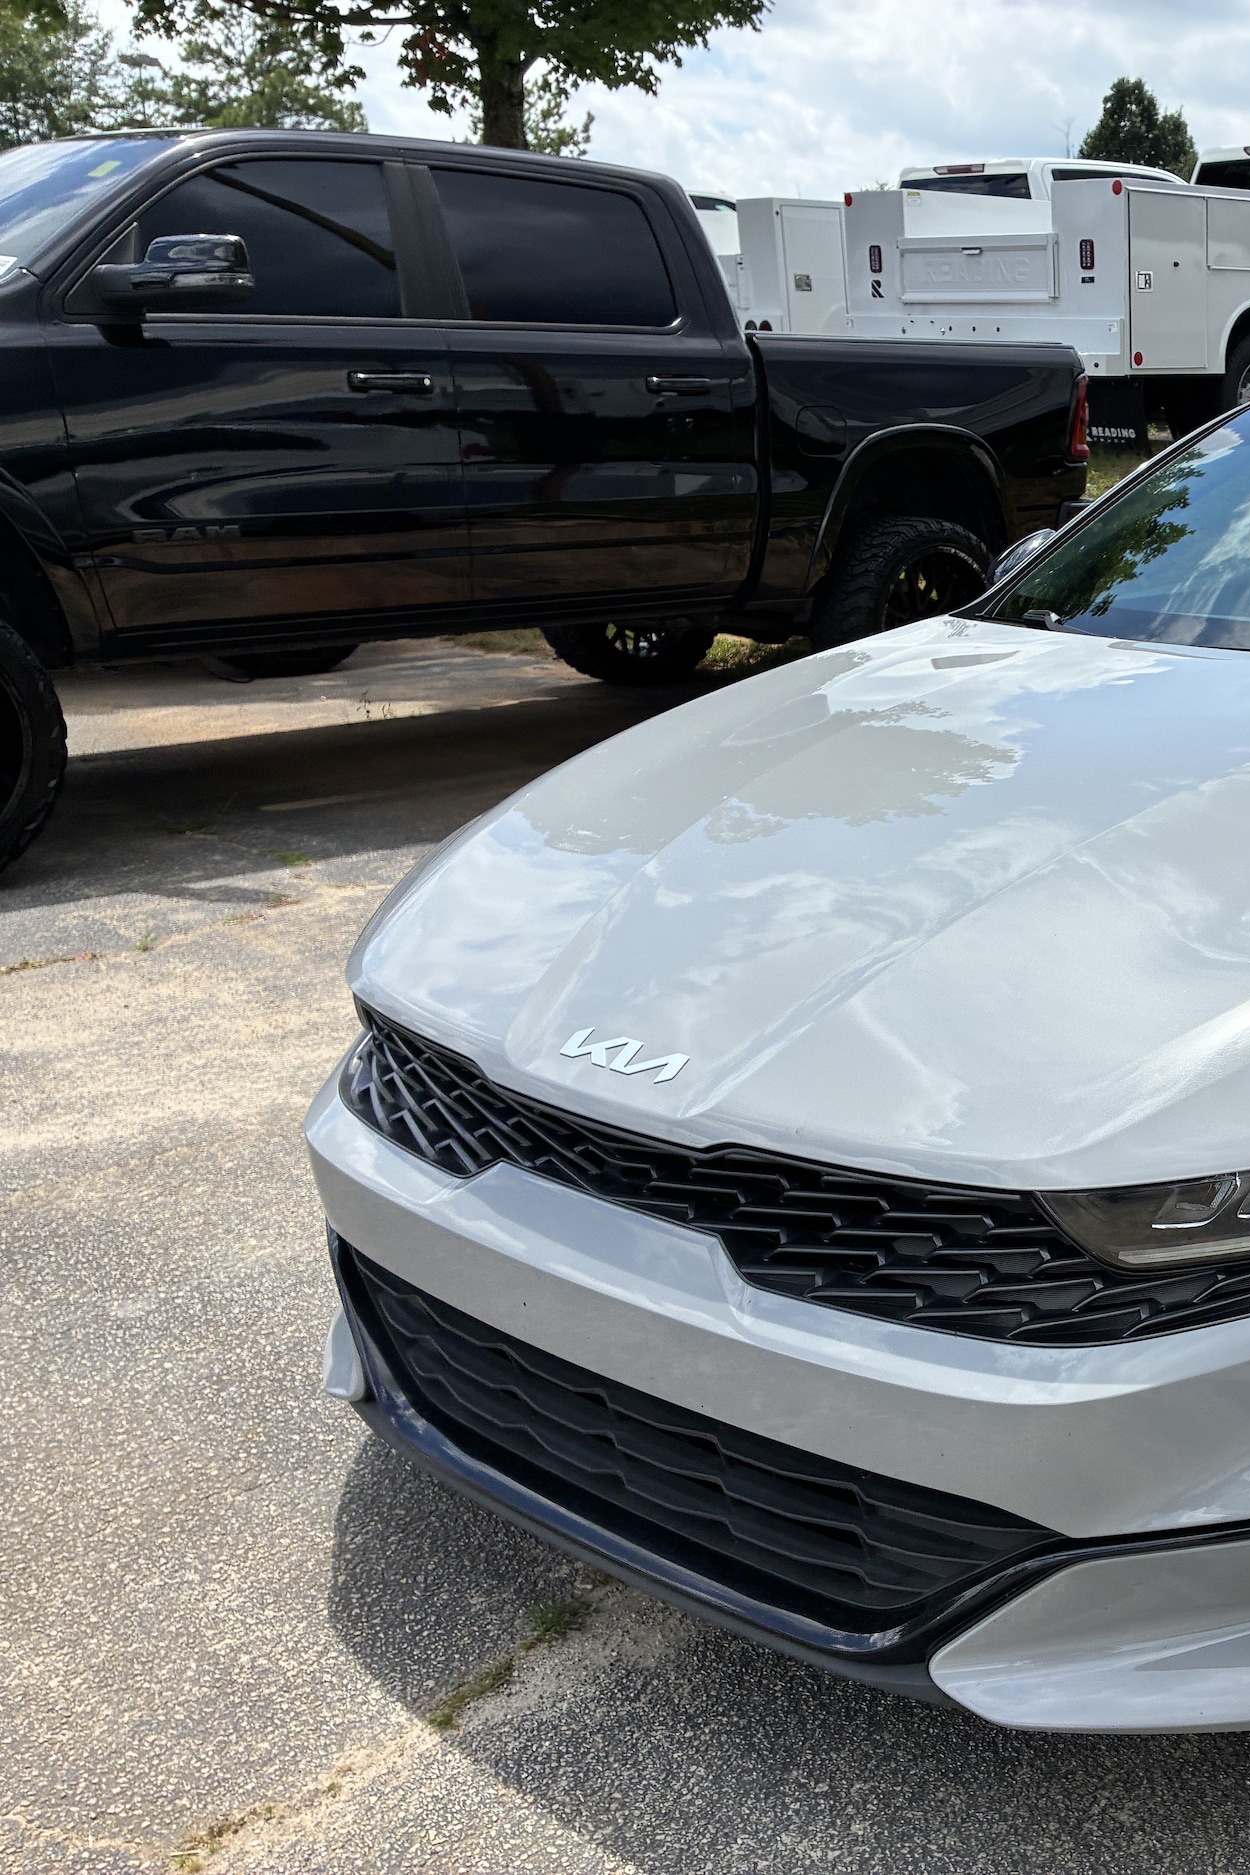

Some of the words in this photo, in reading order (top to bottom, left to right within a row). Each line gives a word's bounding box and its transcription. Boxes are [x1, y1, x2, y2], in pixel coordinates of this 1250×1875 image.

[924, 257, 1030, 284] READING
[1090, 426, 1137, 439] READING
[132, 525, 241, 543] RAM
[559, 1027, 691, 1084] KIA
